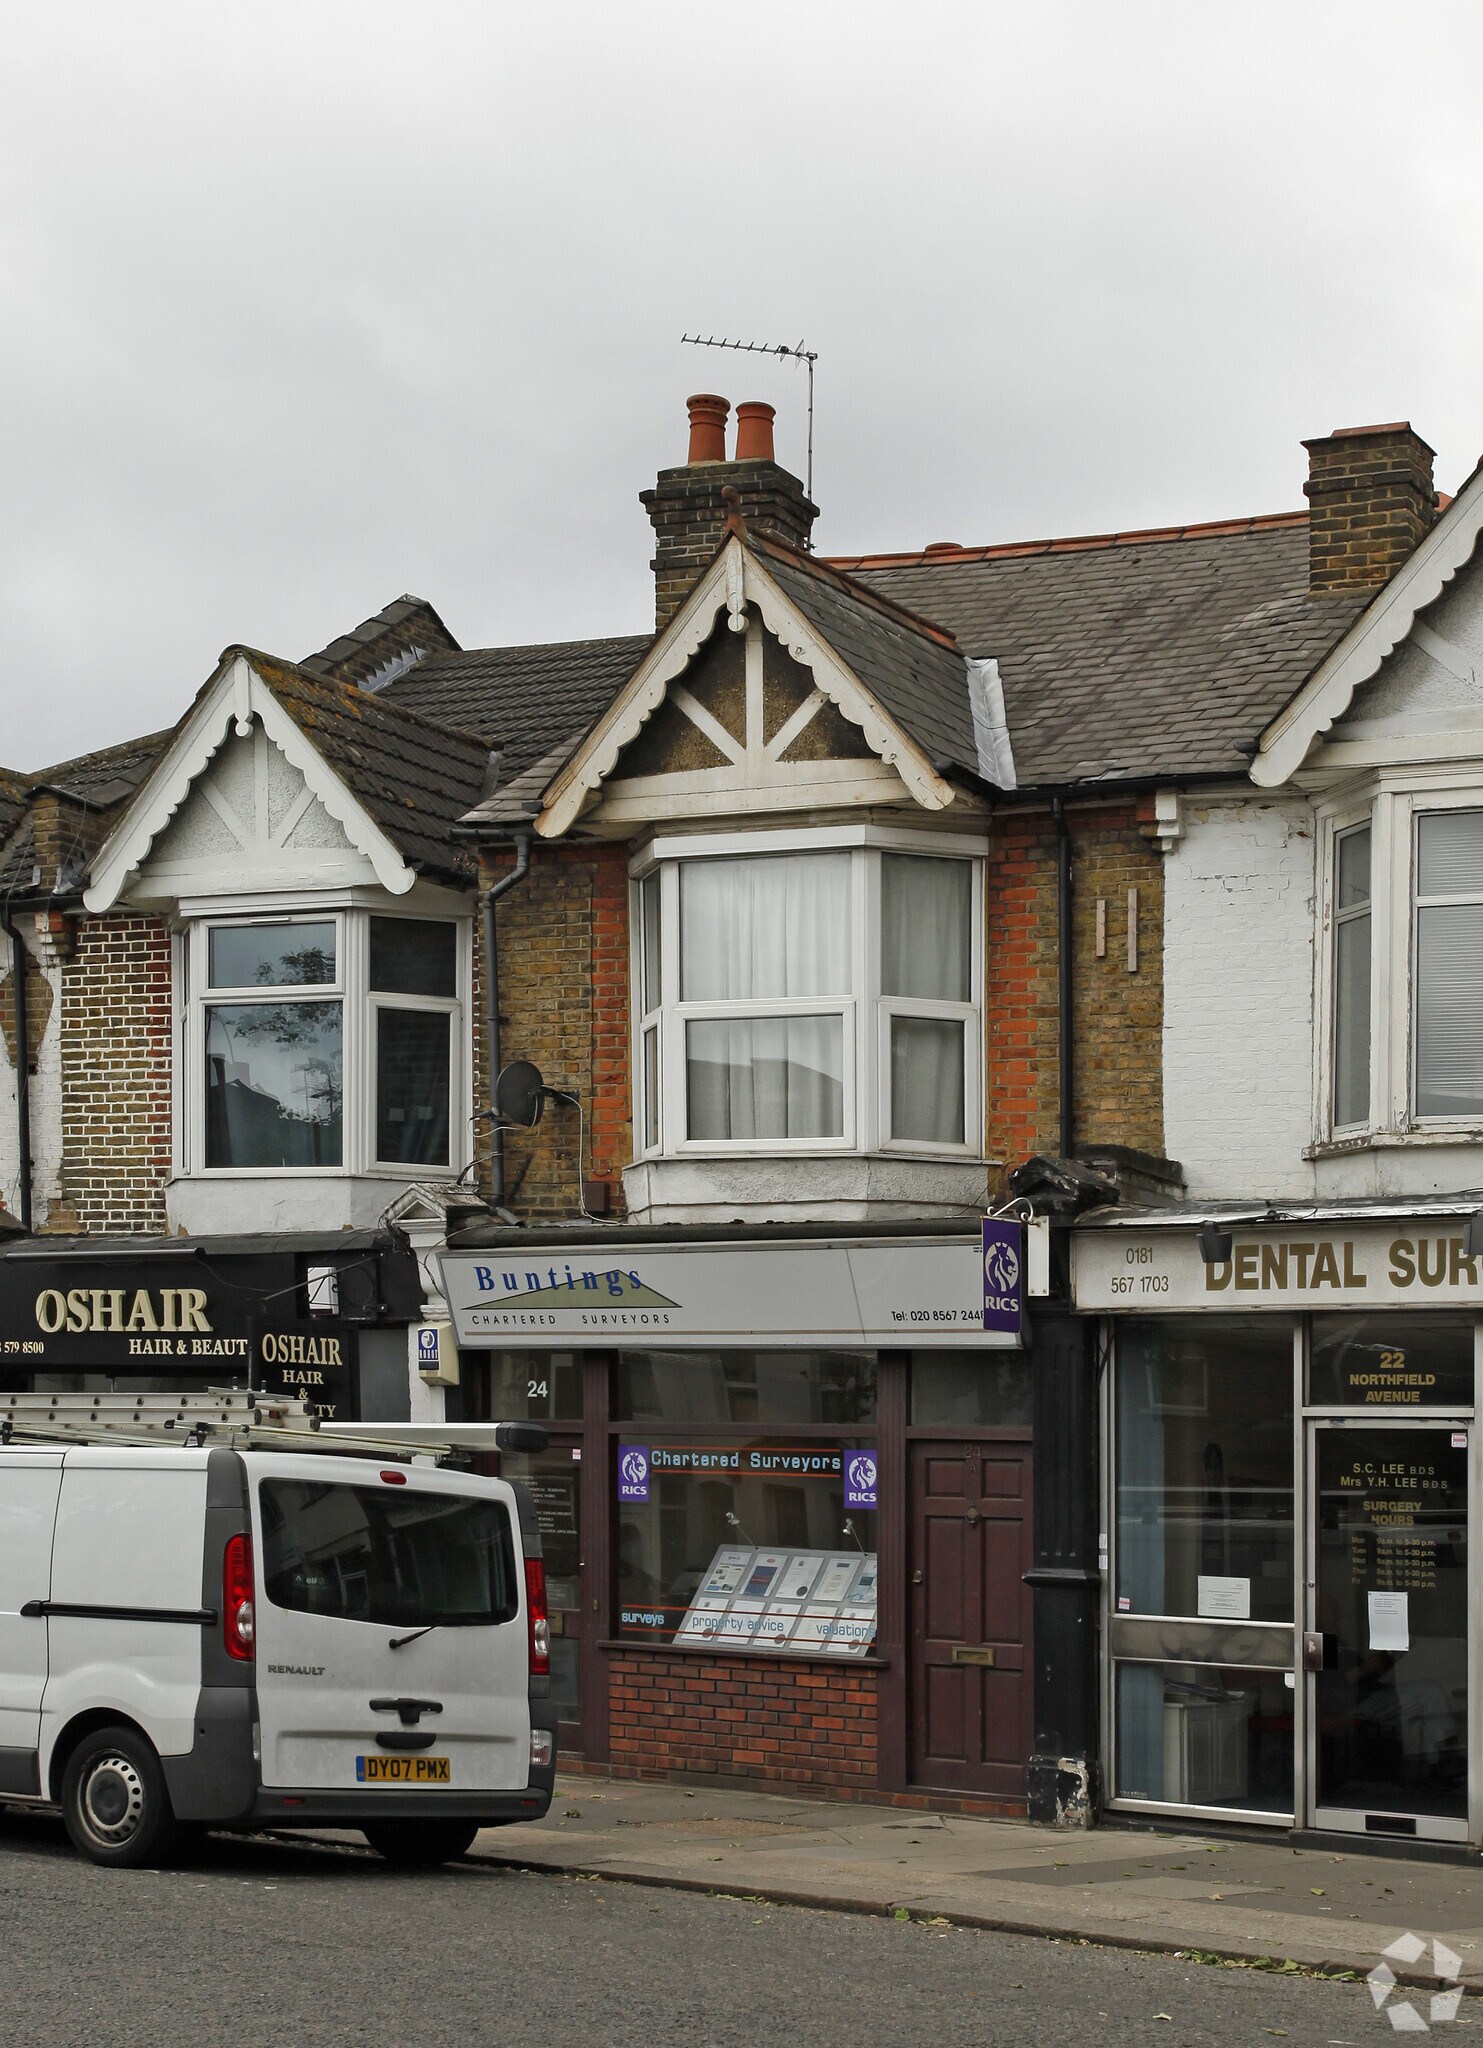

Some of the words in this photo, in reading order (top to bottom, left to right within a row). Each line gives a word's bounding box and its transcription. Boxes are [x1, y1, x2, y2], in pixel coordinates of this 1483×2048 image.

[1125, 1247, 1154, 1265] 0181
[1206, 1241, 1367, 1291] DENTAL
[1388, 1238, 1483, 1289] SUR
[473, 1264, 642, 1296] Buntings
[1110, 1277, 1135, 1294] 567
[1139, 1276, 1169, 1293] 1703
[35, 1288, 213, 1333] OSHAIR
[985, 1296, 1019, 1312] RICS
[472, 1315, 556, 1325] CHARTERED
[582, 1314, 670, 1324] SURVEYORS
[891, 1310, 909, 1321] Tel:
[910, 1310, 930, 1321] 020
[933, 1310, 957, 1321] 8567
[4, 1341, 20, 1354] 579
[22, 1341, 45, 1354] 8500
[129, 1339, 174, 1355] HAIR
[176, 1339, 188, 1355] &
[191, 1339, 249, 1356] BEAUT
[262, 1333, 343, 1366] OSHAIR
[1380, 1353, 1405, 1369] 22
[282, 1369, 325, 1385] HAIR
[1349, 1374, 1436, 1386] NORTHFIELD
[298, 1387, 310, 1400] &
[527, 1380, 548, 1398] 24
[1366, 1391, 1421, 1403] AVENUE
[651, 1450, 740, 1467] Chartered
[750, 1452, 841, 1472] Surveyors
[1353, 1463, 1377, 1474] S.C.
[1382, 1464, 1405, 1475] LEE
[622, 1485, 647, 1495] RICS
[1340, 1476, 1362, 1487] Mrs
[1367, 1477, 1390, 1487] Y.H.
[1395, 1478, 1418, 1488] LEE
[849, 1492, 877, 1502] RICS
[1363, 1501, 1422, 1512] SURGERY
[621, 1611, 665, 1625] surveys
[692, 1615, 743, 1632] property
[747, 1618, 784, 1632] advice
[816, 1622, 876, 1638] valuations
[268, 1664, 325, 1676] RENAULT
[368, 1758, 411, 1778] DY07
[416, 1759, 449, 1779] PMX
